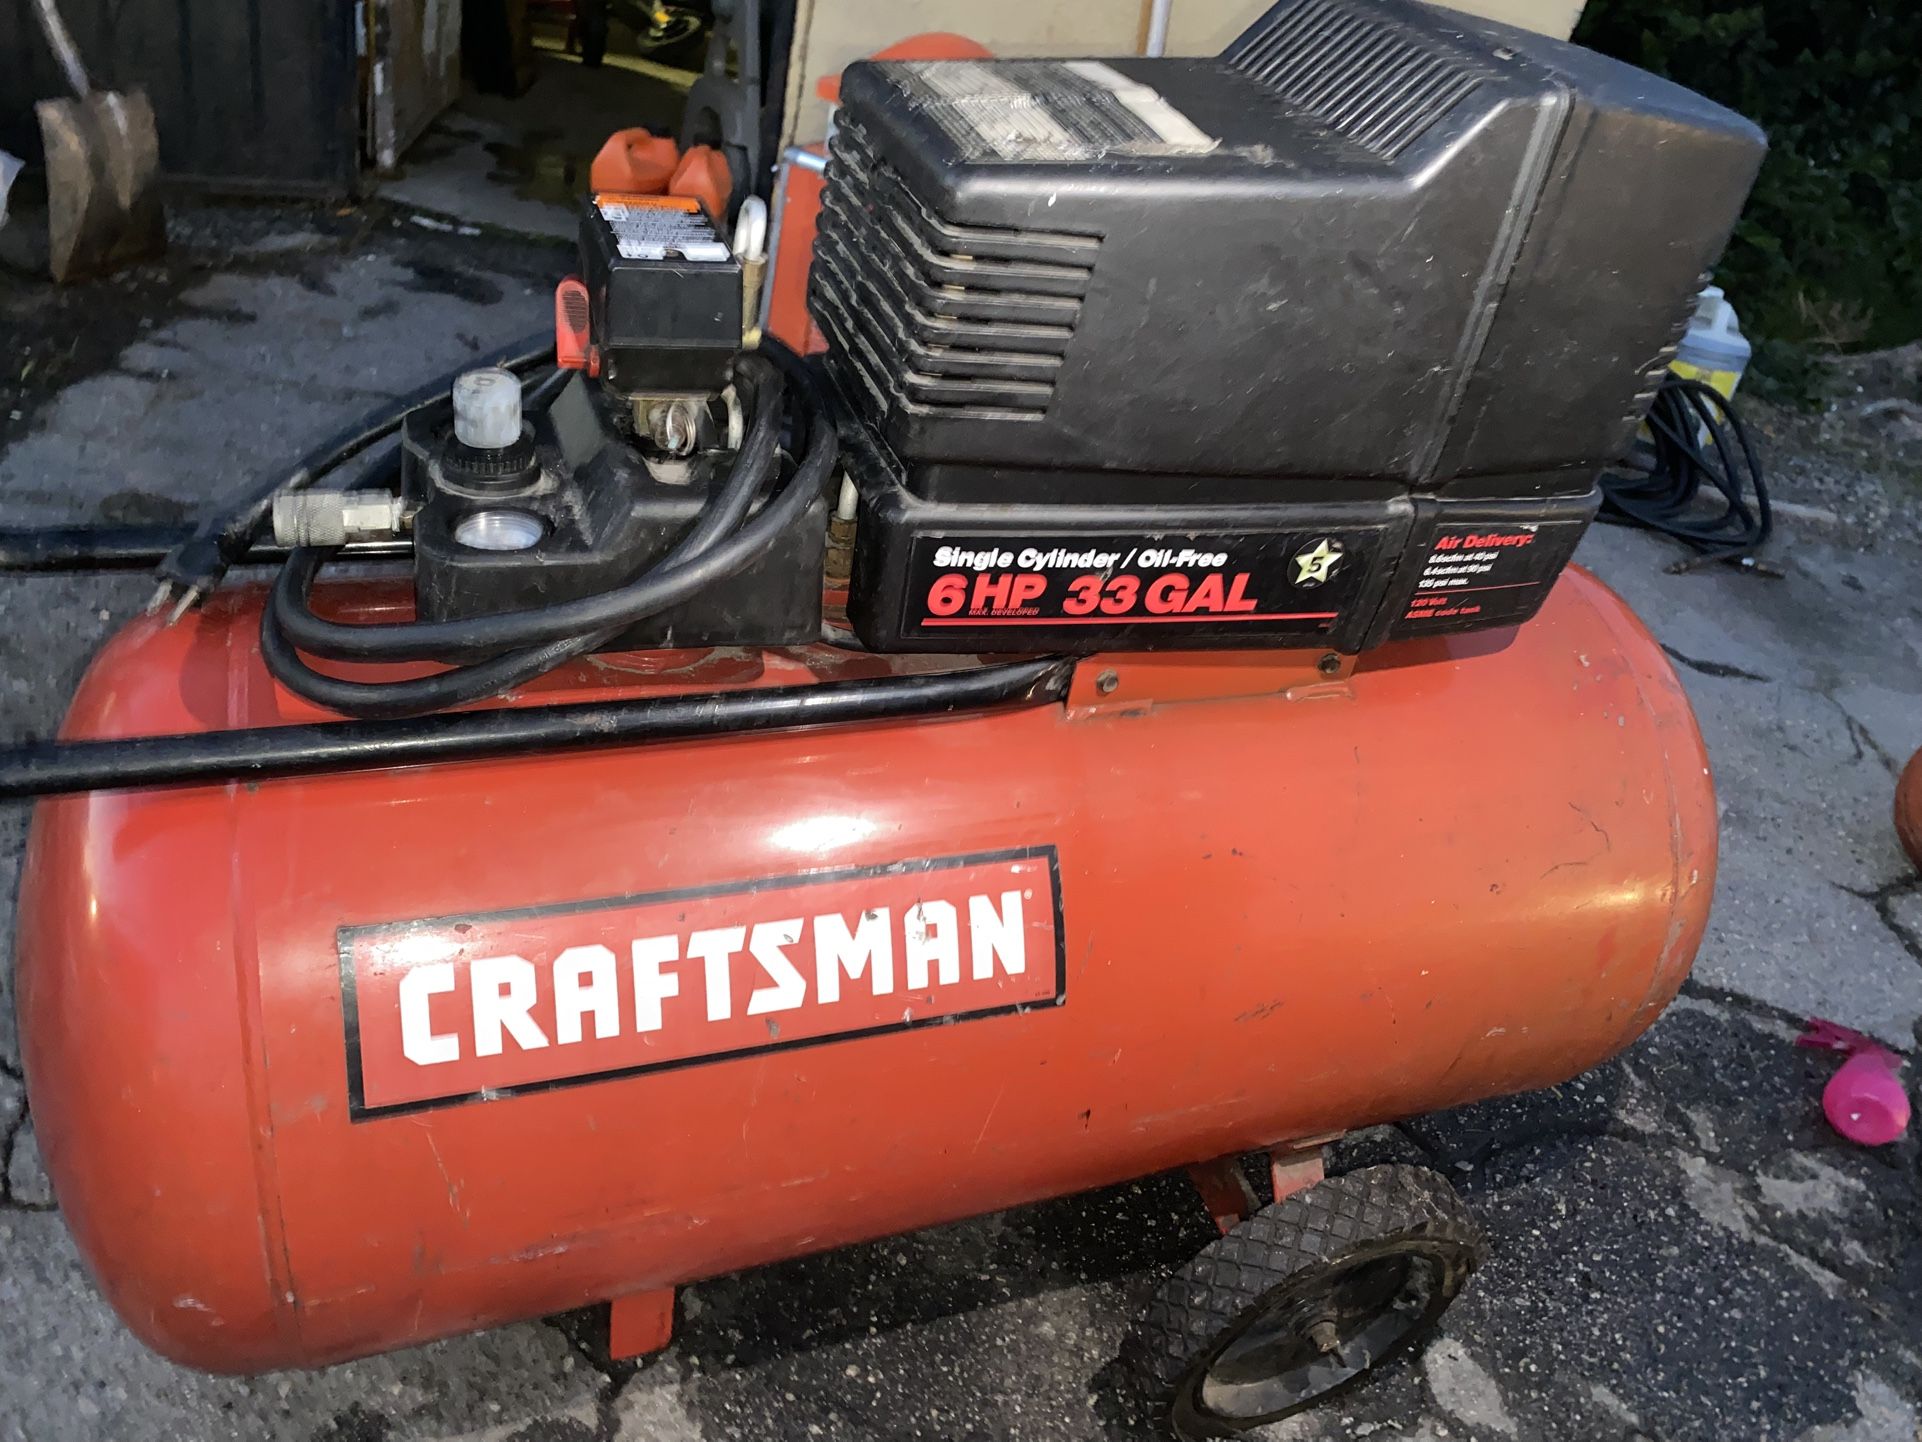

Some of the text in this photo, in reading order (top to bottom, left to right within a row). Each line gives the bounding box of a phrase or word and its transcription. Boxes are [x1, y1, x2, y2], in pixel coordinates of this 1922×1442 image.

[1435, 534, 1534, 550] Air Delivery:
[933, 545, 1228, 571] Single Cylinder / Oil-Free
[1307, 556, 1325, 573] 5
[927, 572, 1258, 616] 6 HP 33 GAL
[991, 606, 1041, 616] DEVELOPED
[399, 890, 1026, 1066] CRAFTSMAN
